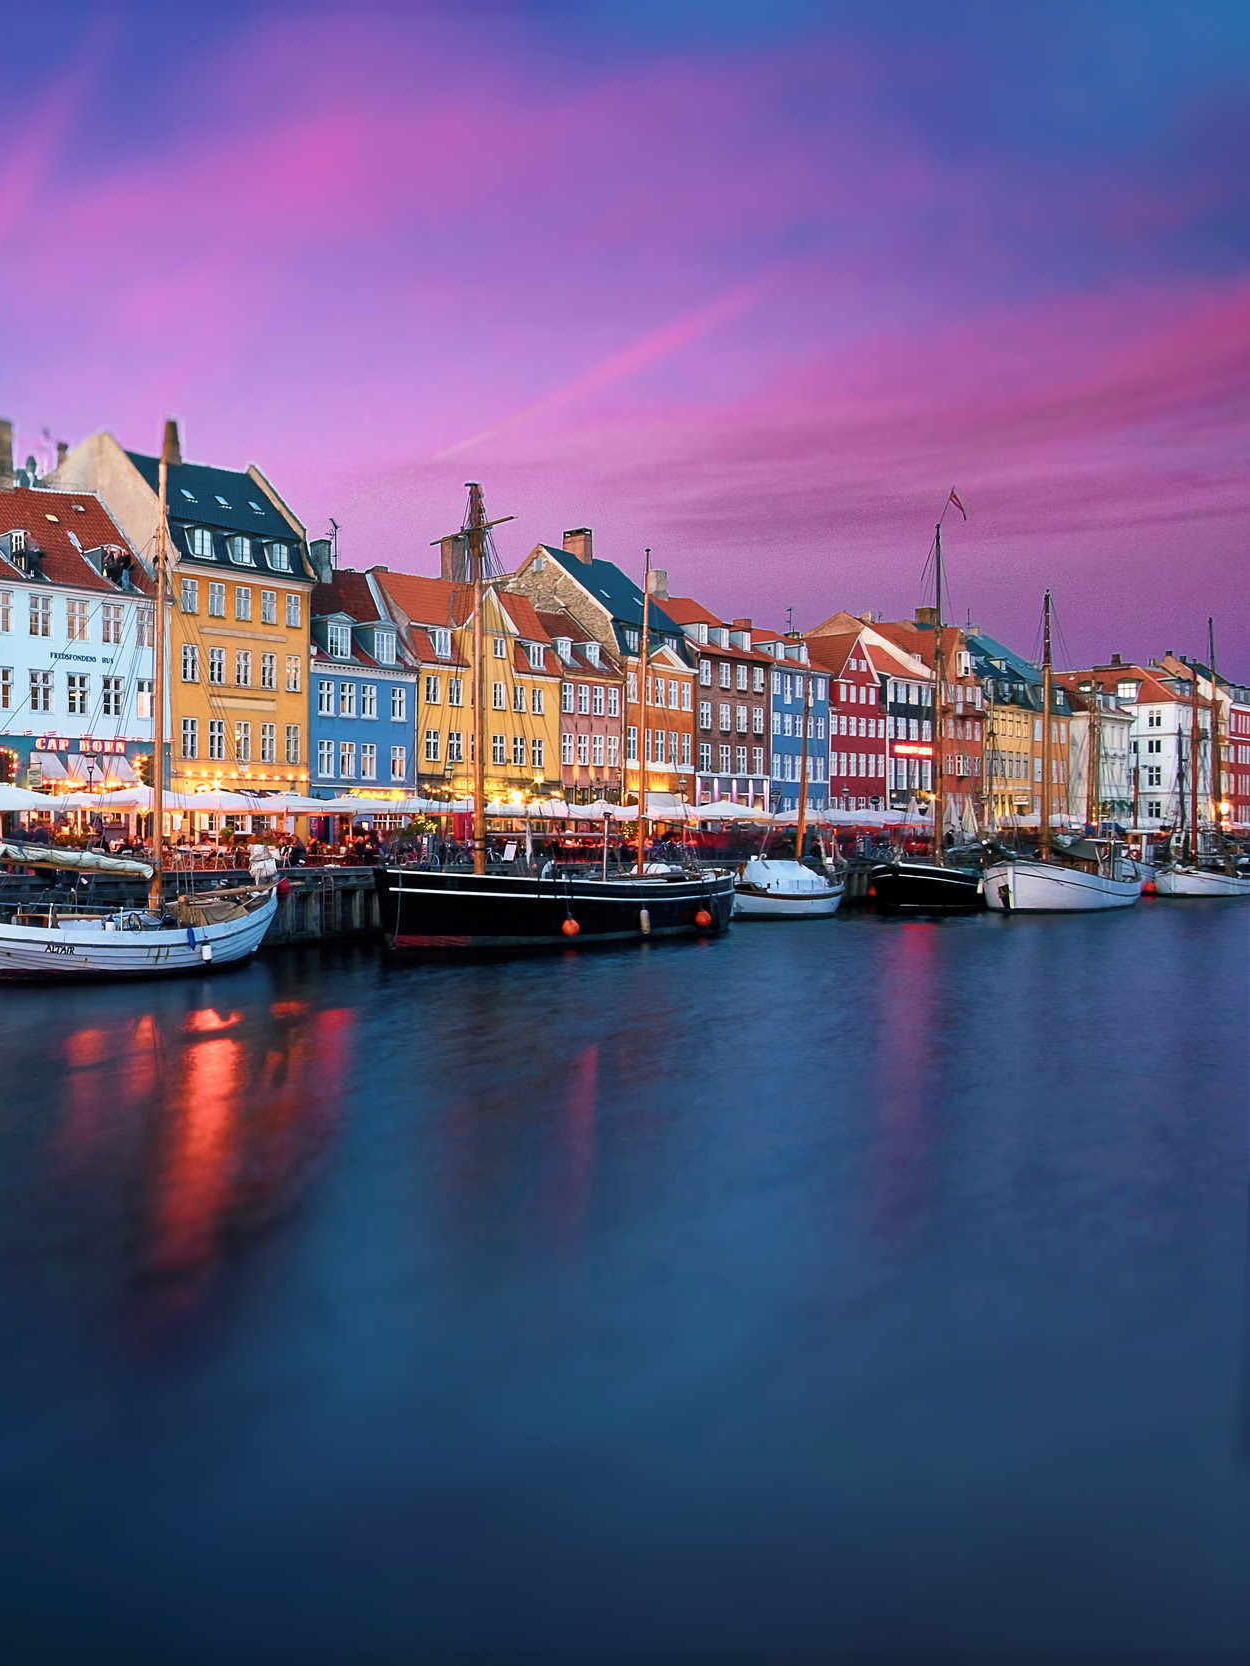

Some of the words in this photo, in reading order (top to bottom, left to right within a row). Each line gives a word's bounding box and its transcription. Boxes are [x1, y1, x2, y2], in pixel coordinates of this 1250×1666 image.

[35, 738, 70, 751] CAP
[79, 740, 125, 753] HORN
[44, 944, 75, 955] ALTAIR
